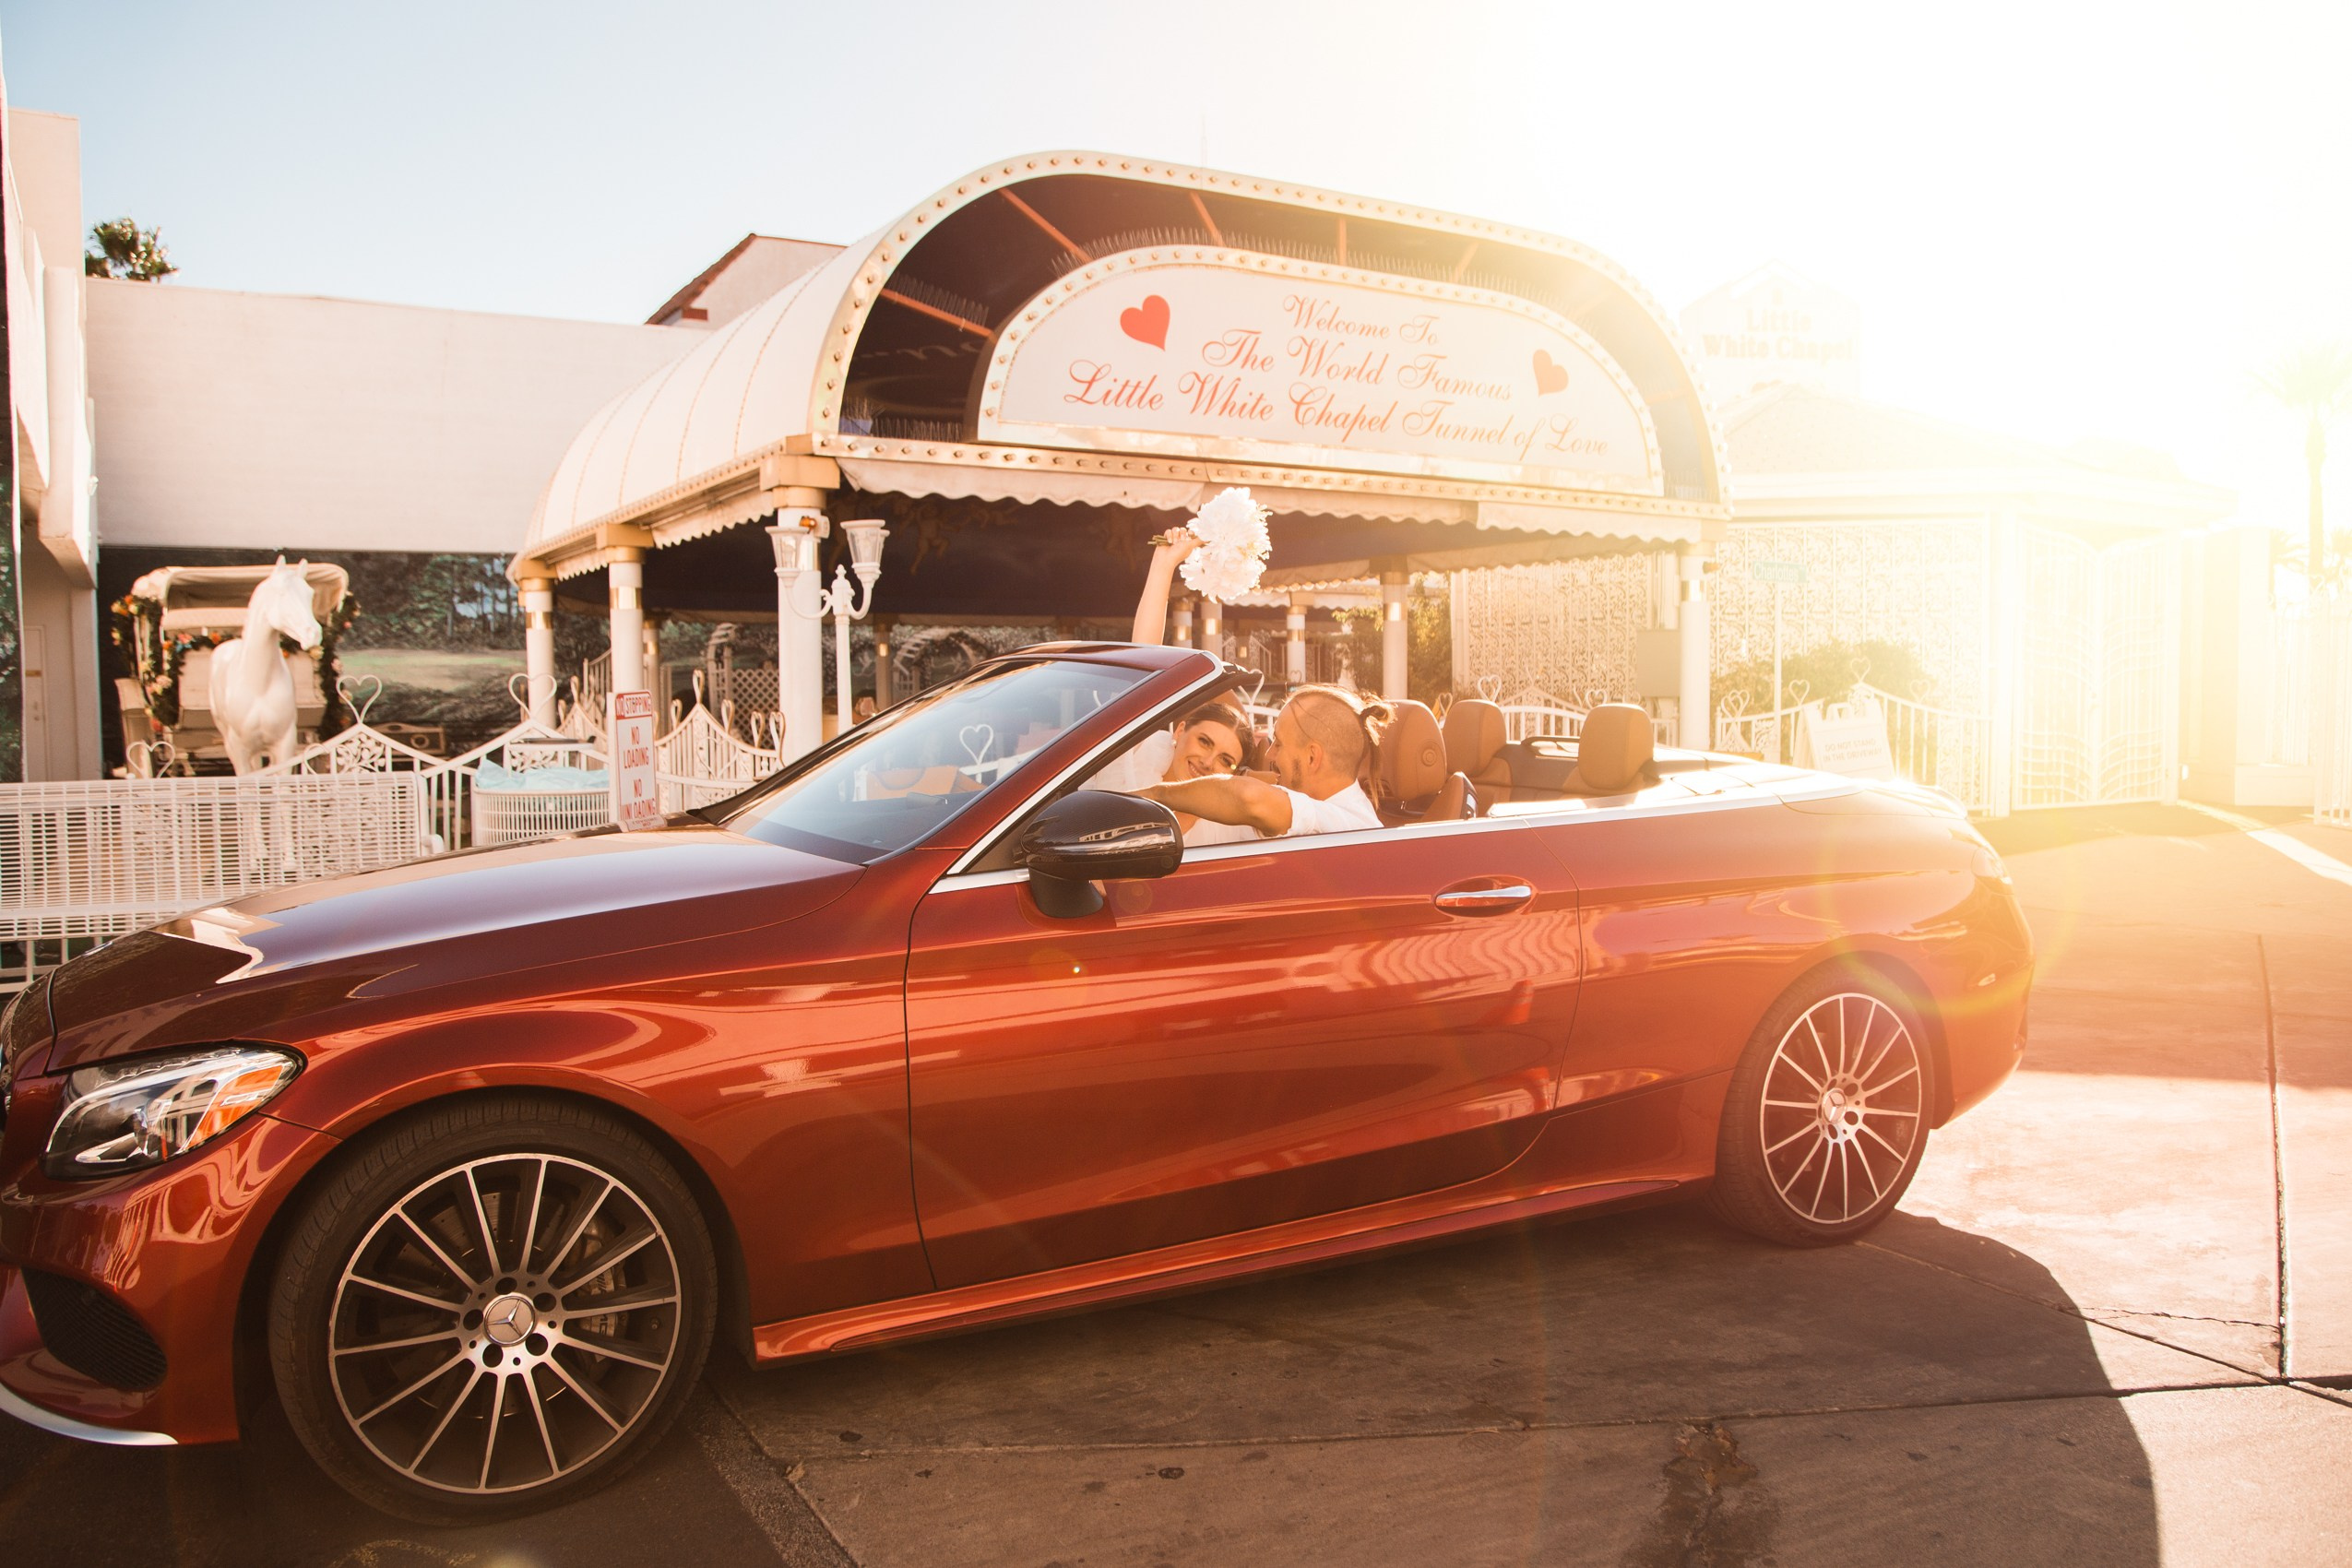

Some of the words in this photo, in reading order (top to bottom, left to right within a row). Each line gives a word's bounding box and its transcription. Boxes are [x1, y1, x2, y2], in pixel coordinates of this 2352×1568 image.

[1282, 294, 1392, 339] Welcome
[1399, 315, 1440, 346] To
[1745, 308, 1813, 333] Little
[1702, 334, 1769, 358] White
[1776, 335, 1854, 368] Chapel
[1202, 328, 1275, 373] The
[1287, 336, 1390, 386] World
[1397, 353, 1514, 401] Famous
[1063, 359, 1166, 410] Little
[1178, 371, 1275, 422] White
[1289, 382, 1399, 443] Chapel
[1402, 400, 1515, 445] Tunnel
[1514, 416, 1548, 461] of
[1545, 413, 1610, 456] Love
[626, 696, 651, 715] STOPPING
[631, 726, 640, 745] NO
[1824, 743, 1836, 752] DO
[1837, 741, 1851, 750] NOT
[1853, 738, 1876, 746] STAND
[624, 747, 649, 769] LOADING
[1832, 752, 1846, 761] THE
[1847, 747, 1883, 760] DRIVEWAY
[633, 778, 643, 798] NO
